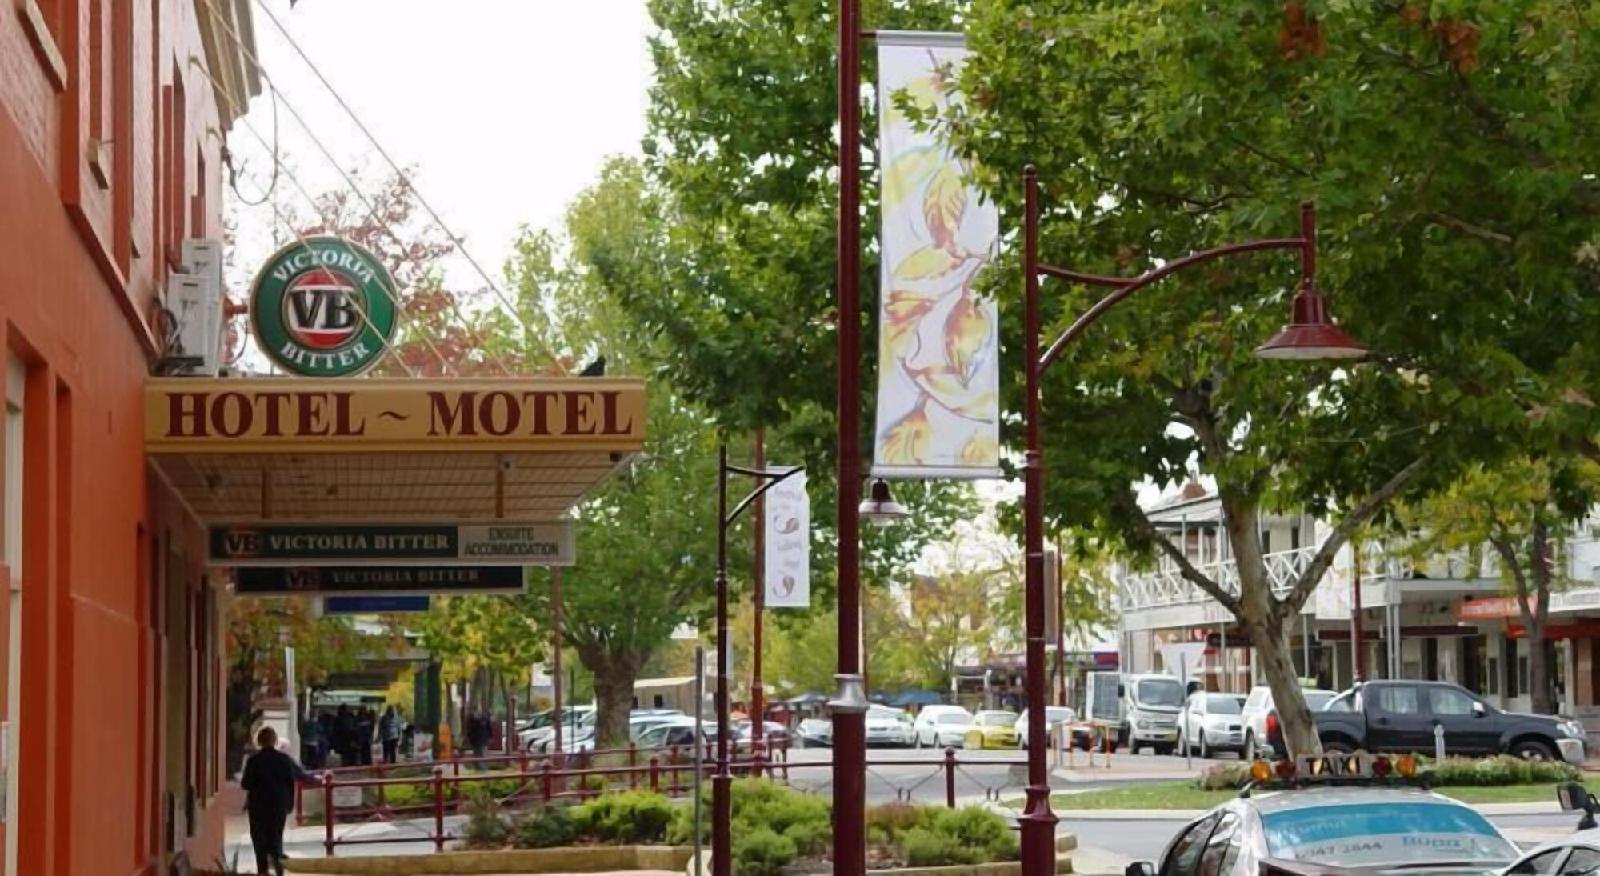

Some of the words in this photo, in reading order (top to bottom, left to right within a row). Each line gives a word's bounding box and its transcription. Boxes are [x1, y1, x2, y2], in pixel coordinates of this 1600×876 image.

[272, 250, 376, 283] VICTORIA
[289, 289, 357, 330] VB
[281, 343, 369, 368] BITTER
[166, 392, 366, 437] HOTEL
[427, 391, 633, 435] MOTEL
[225, 532, 261, 554] VB
[270, 535, 368, 549] VICTORIA
[374, 534, 449, 549] BITTER
[489, 527, 534, 540] ENSUITE
[464, 542, 558, 555] ACCOMMODATION
[334, 570, 411, 582] VICTORIA
[418, 570, 479, 582] BITTER
[1306, 757, 1361, 775] TAXI
